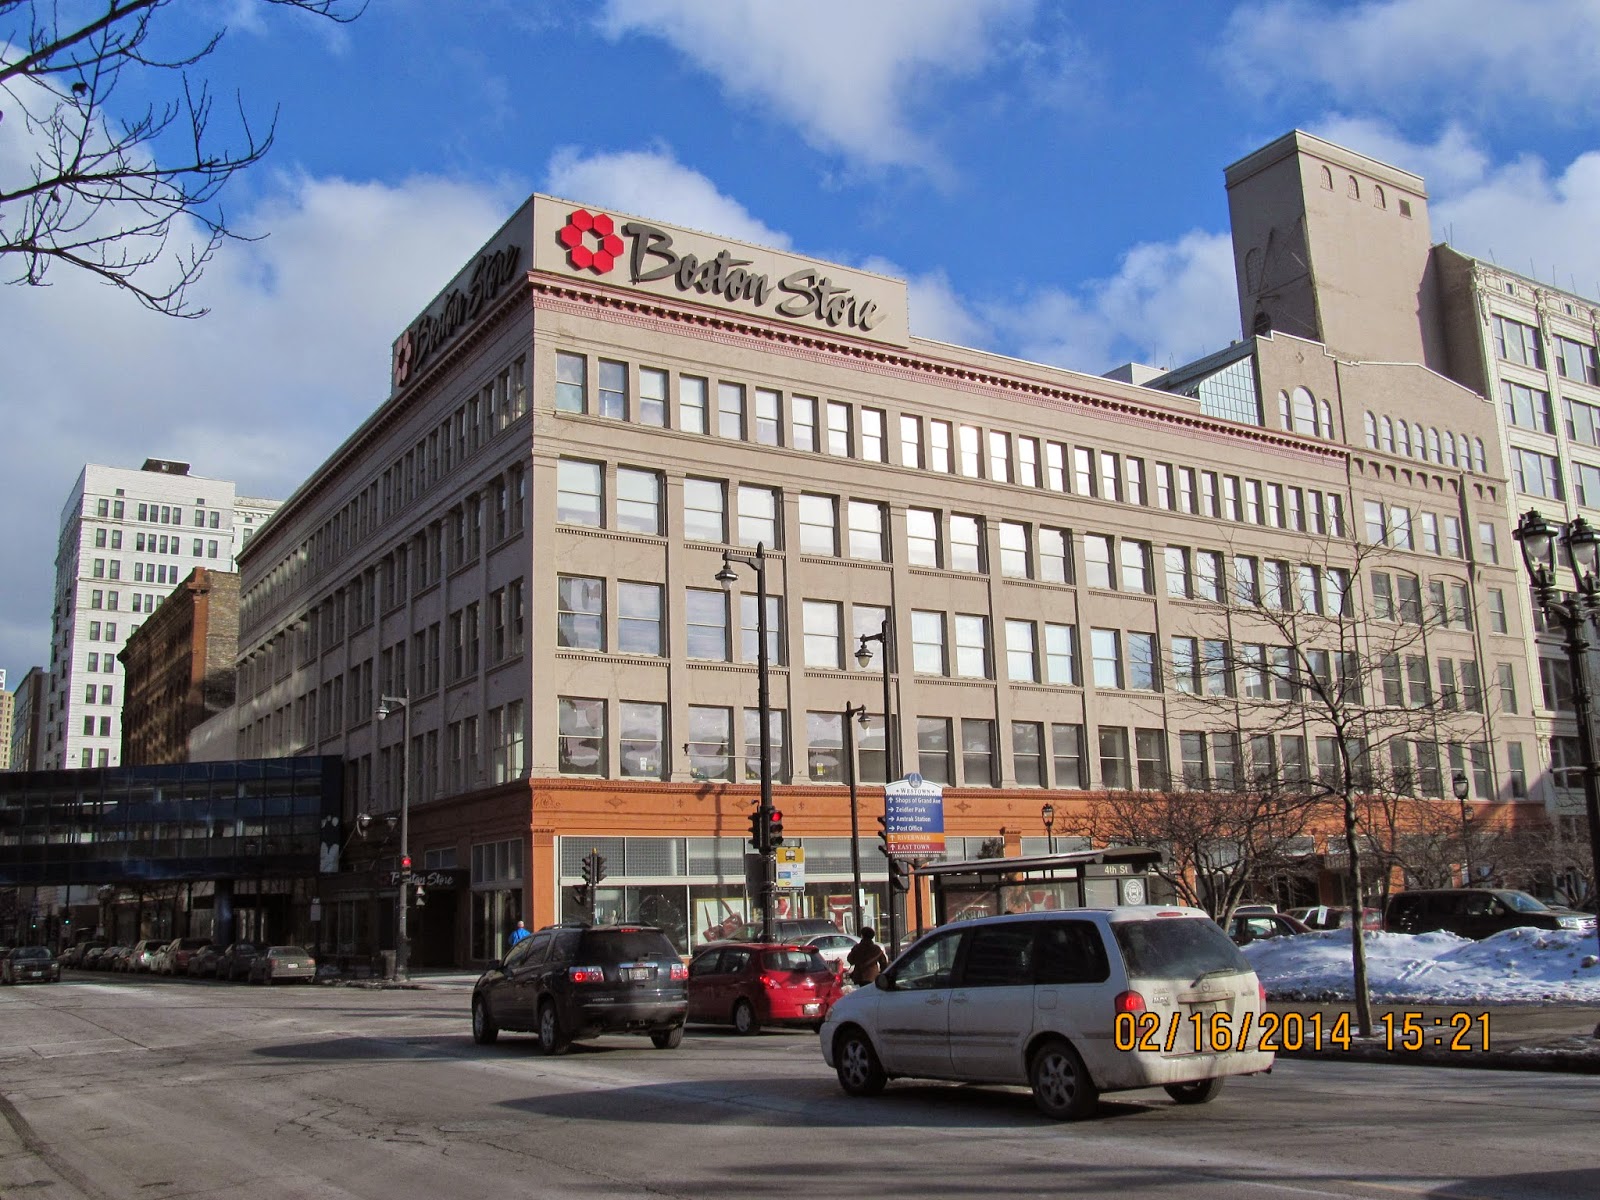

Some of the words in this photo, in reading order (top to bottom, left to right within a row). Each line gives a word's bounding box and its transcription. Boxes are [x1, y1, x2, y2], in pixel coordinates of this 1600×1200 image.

[622, 222, 777, 305] Boston
[774, 267, 889, 331] Store
[1104, 865, 1117, 874] 4th
[1119, 865, 1128, 874] St
[426, 872, 454, 886] Store
